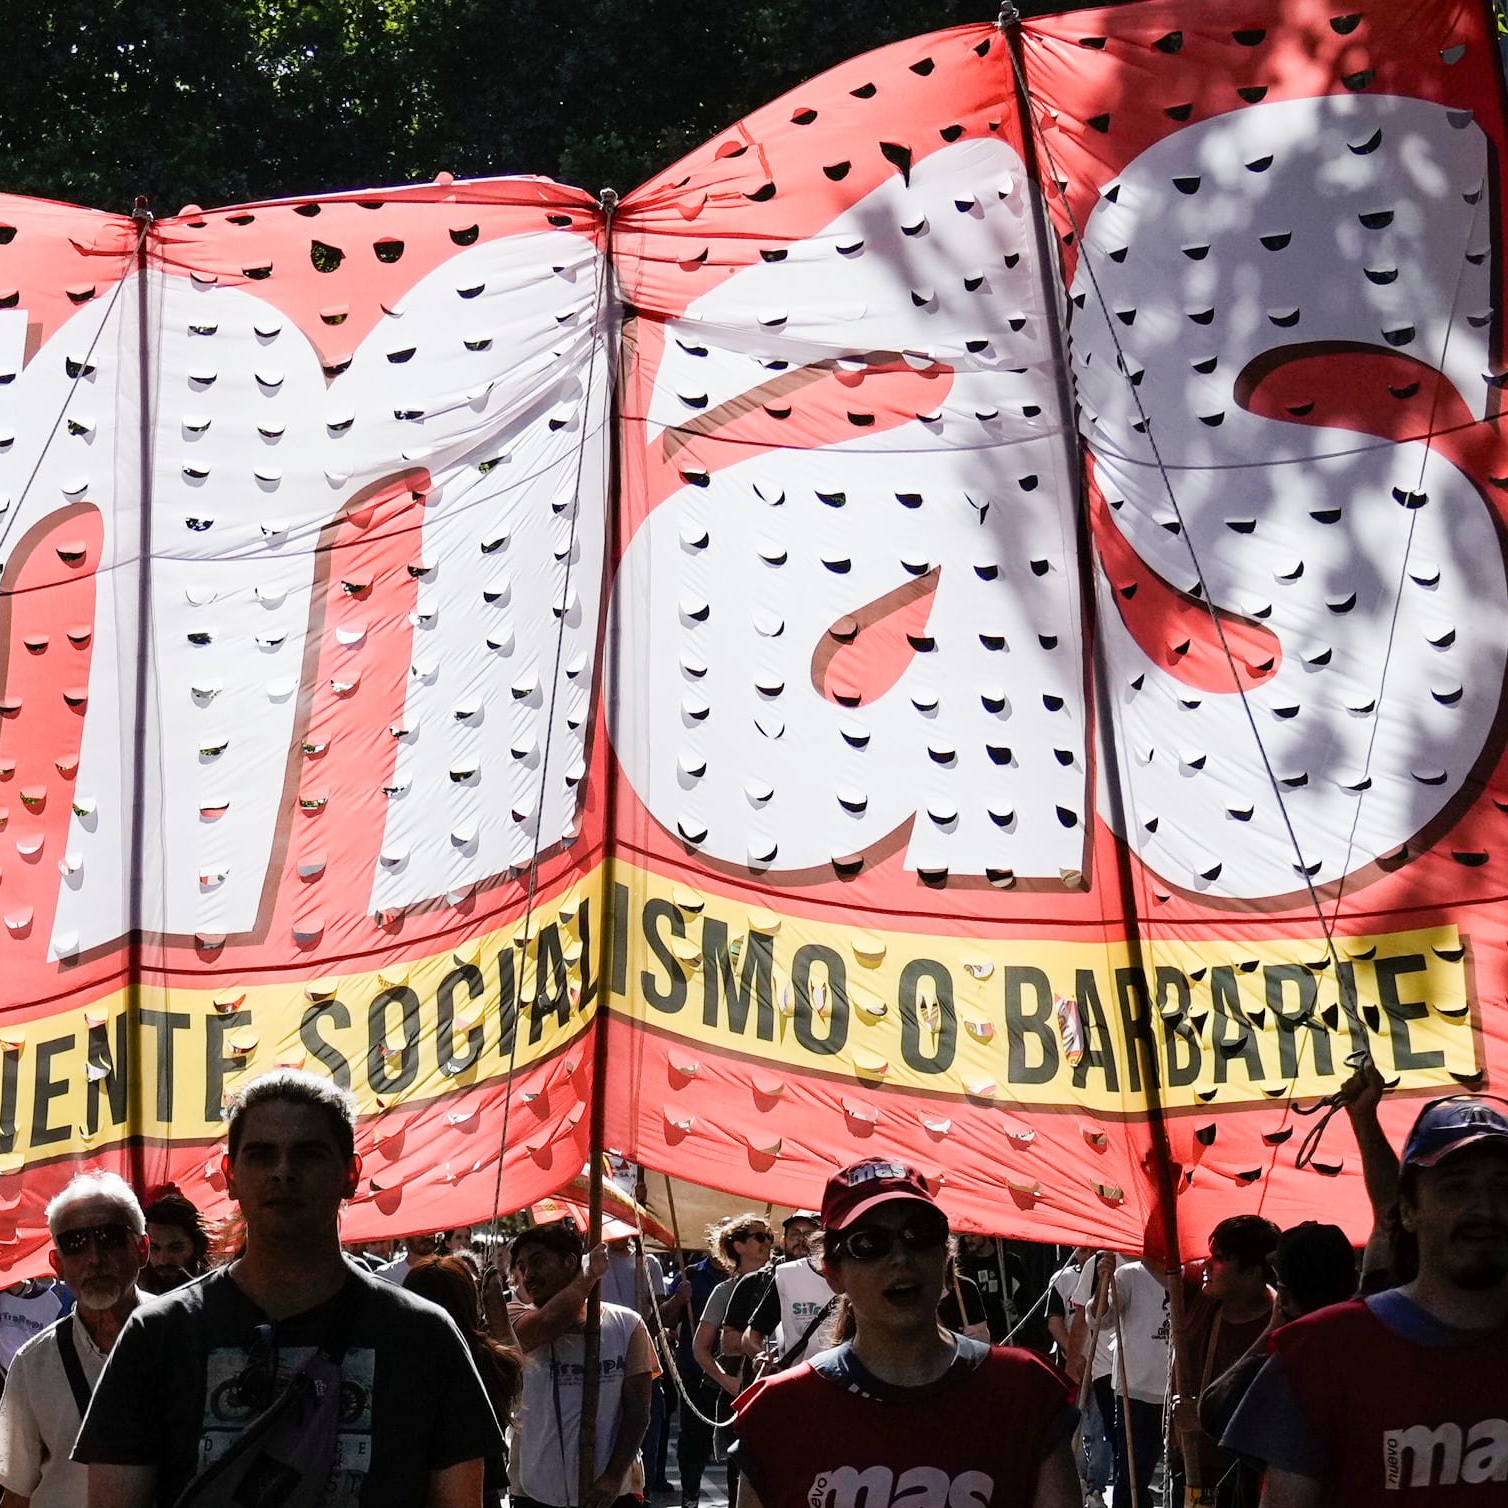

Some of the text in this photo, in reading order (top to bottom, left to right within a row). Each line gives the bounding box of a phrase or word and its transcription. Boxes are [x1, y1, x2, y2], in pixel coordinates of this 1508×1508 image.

[299, 881, 850, 1095] SOCIALISMO
[897, 958, 956, 1074] O
[1003, 953, 1445, 1092] BARBARIE
[848, 1163, 907, 1187] mas
[1386, 1437, 1399, 1485] nuevo
